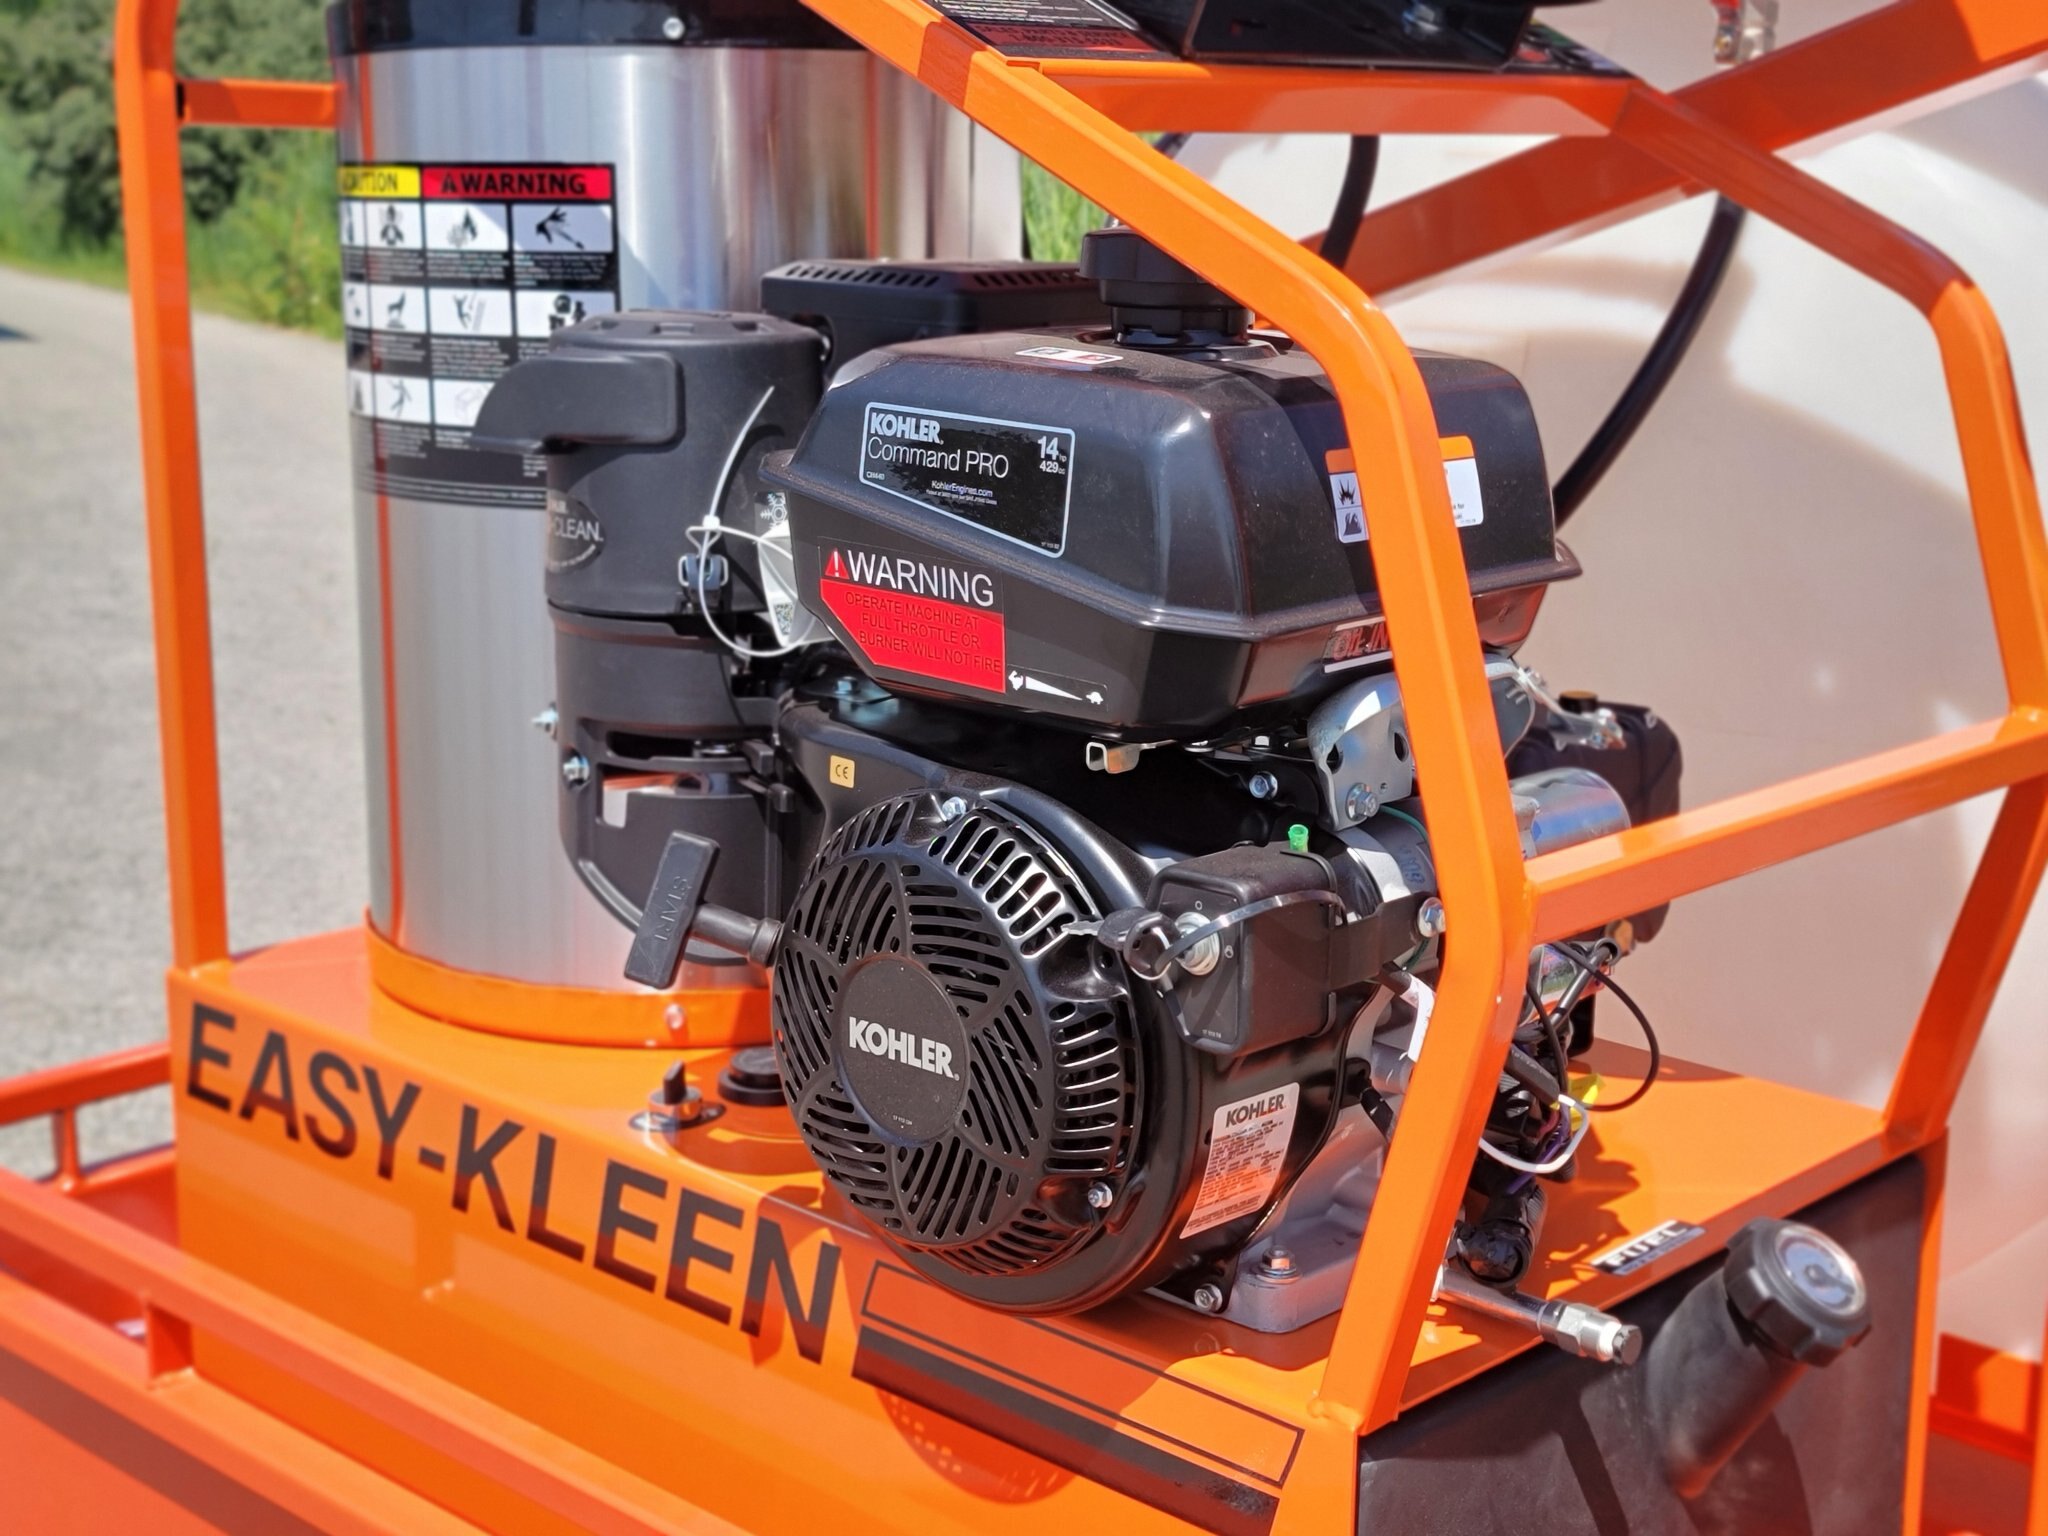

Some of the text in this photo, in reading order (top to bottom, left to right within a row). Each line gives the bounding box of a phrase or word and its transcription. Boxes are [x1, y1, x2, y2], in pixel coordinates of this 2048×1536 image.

[460, 172, 586, 195] WARNING
[869, 412, 942, 444] KOHLER
[868, 437, 1009, 478] Command PRO
[1037, 435, 1059, 461] 14
[1039, 459, 1059, 474] 429
[931, 480, 993, 498] KohlerEngines.com
[848, 550, 994, 607] WARNING
[845, 591, 980, 629] OPERATE MACHINE AT
[862, 613, 981, 650] FULL THROTTLE OR
[859, 631, 1002, 674] BURNER WILL NOT FIRE
[849, 1016, 955, 1078] KOHLER
[1225, 1093, 1285, 1128] KOHLER
[187, 1001, 842, 1366] EASY-KLEEN
[1602, 1221, 1690, 1267] FUEL
